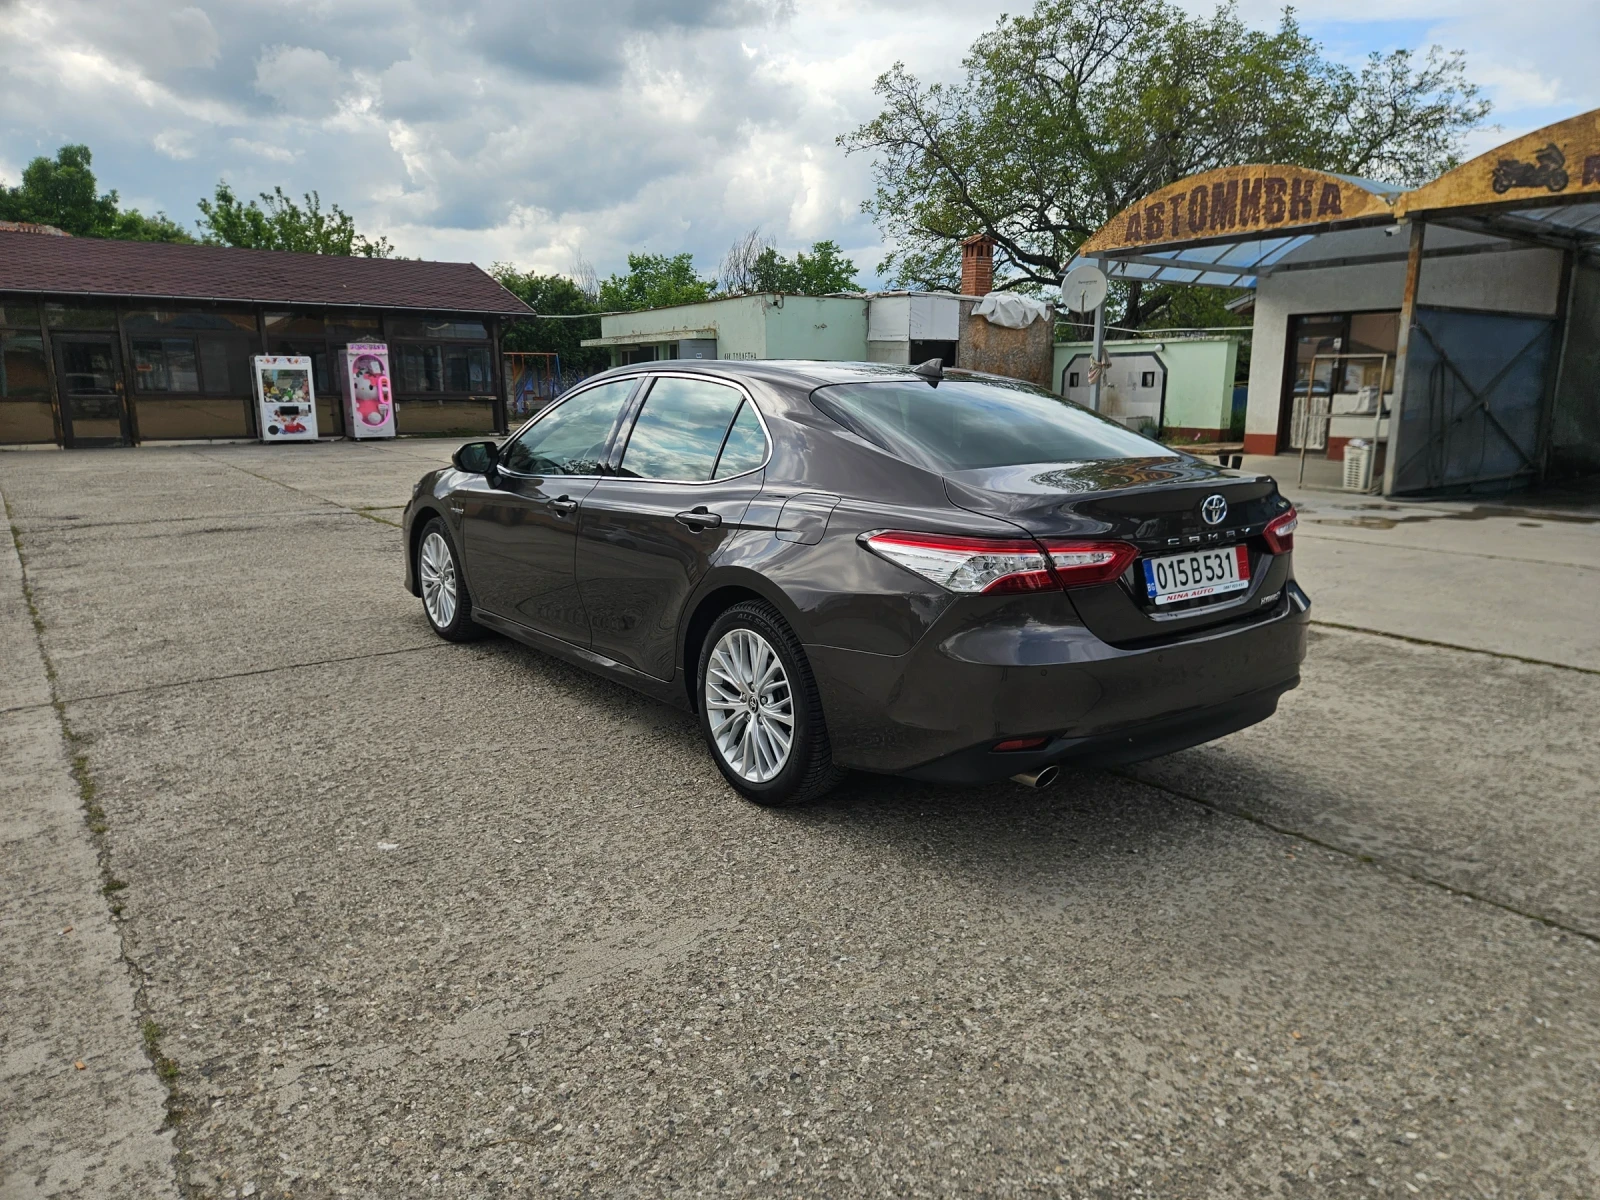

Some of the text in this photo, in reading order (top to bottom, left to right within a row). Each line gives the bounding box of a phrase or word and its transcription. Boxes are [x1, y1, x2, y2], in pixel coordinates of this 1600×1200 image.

[1125, 178, 1343, 242] АВТОМИВКА
[1167, 528, 1250, 545] CAMRY
[1156, 552, 1234, 590] 015B531
[1166, 588, 1214, 602] NINA AUTO
[737, 613, 753, 622] ALL
